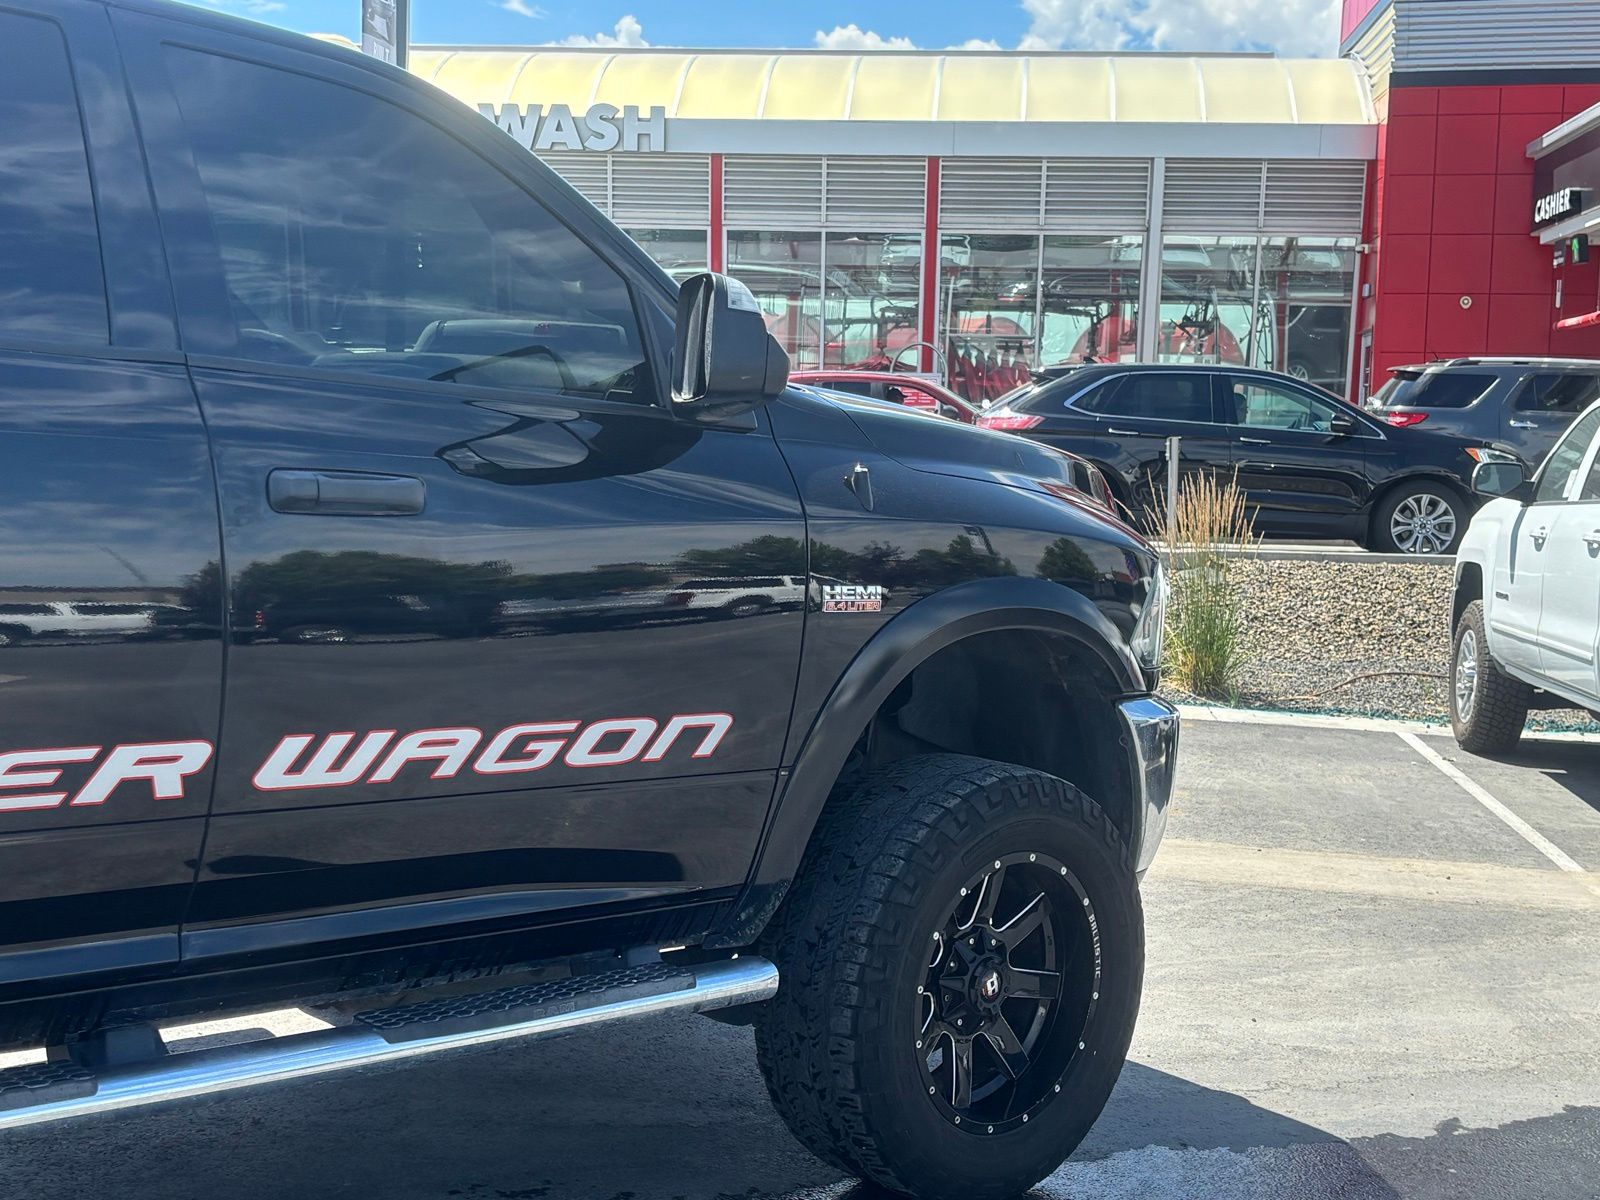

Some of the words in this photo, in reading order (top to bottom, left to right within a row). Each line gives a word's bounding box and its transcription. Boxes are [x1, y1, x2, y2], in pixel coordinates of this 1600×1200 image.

[478, 103, 665, 152] WASH
[1534, 187, 1571, 223] CASHIER
[822, 585, 881, 600] HEMI
[847, 601, 880, 611] LITER
[252, 712, 733, 791] WAGON
[1088, 913, 1102, 979] BALLISTIC
